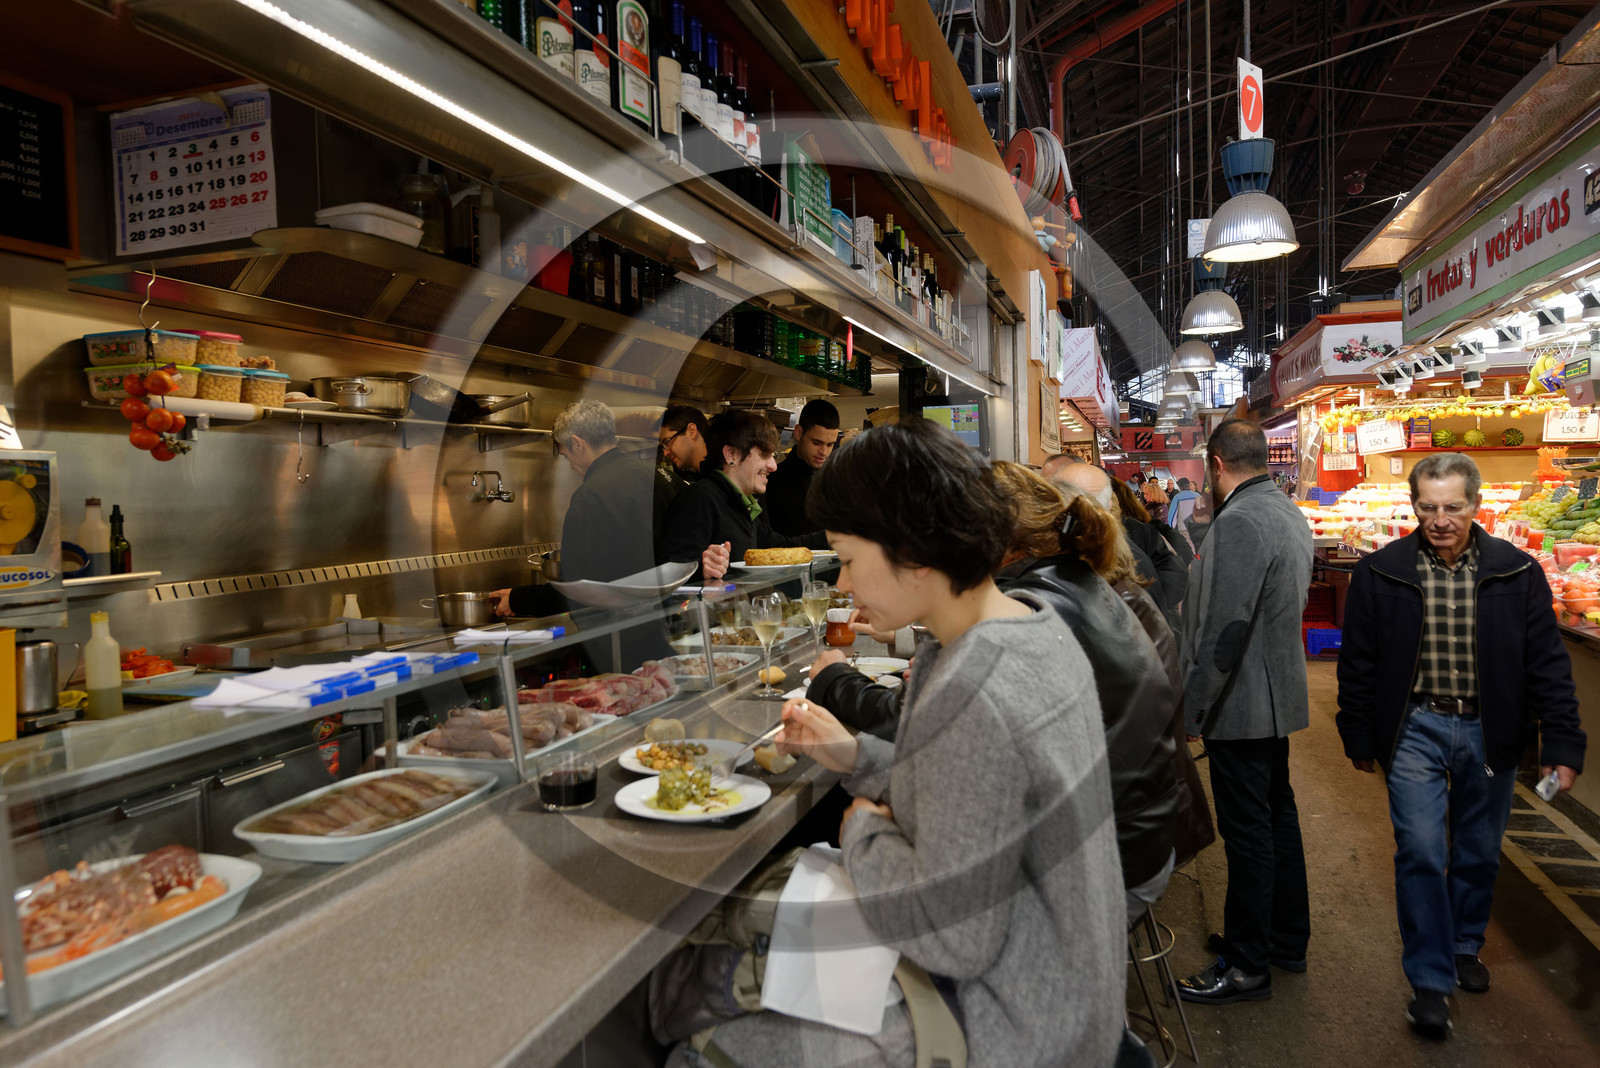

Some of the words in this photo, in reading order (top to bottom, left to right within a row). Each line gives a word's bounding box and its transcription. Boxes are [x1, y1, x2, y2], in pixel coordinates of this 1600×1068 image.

[1246, 84, 1256, 121] 7
[156, 116, 223, 136] Desembre
[149, 152, 155, 161] 1
[169, 148, 177, 158] 2
[188, 144, 196, 154] 3
[209, 140, 218, 149] 4
[230, 136, 238, 146] 5
[251, 132, 260, 142] 6
[130, 174, 138, 184] 7
[150, 171, 158, 181] 8
[169, 167, 177, 177] 9
[186, 162, 202, 173] 10
[207, 158, 222, 170] 11
[228, 154, 245, 166] 12
[249, 150, 265, 162] 13
[128, 193, 144, 204] 14
[148, 189, 163, 200] 15
[168, 185, 183, 197] 16
[187, 182, 204, 194] 17
[208, 178, 225, 190] 18
[229, 174, 246, 186] 19
[250, 171, 268, 183] 20
[129, 211, 143, 223] 21
[148, 208, 165, 219] 22
[168, 204, 184, 216] 23
[188, 201, 205, 213] 24
[209, 198, 226, 210] 25
[230, 194, 248, 206] 26
[252, 190, 268, 202] 27
[130, 231, 146, 242] 28
[149, 227, 165, 239] 29
[169, 224, 186, 236] 30
[189, 221, 205, 232] 31
[1427, 260, 1463, 304] frutas
[1470, 248, 1478, 290] y
[1485, 188, 1570, 268] verduras
[0, 570, 51, 582] UCOSOL
